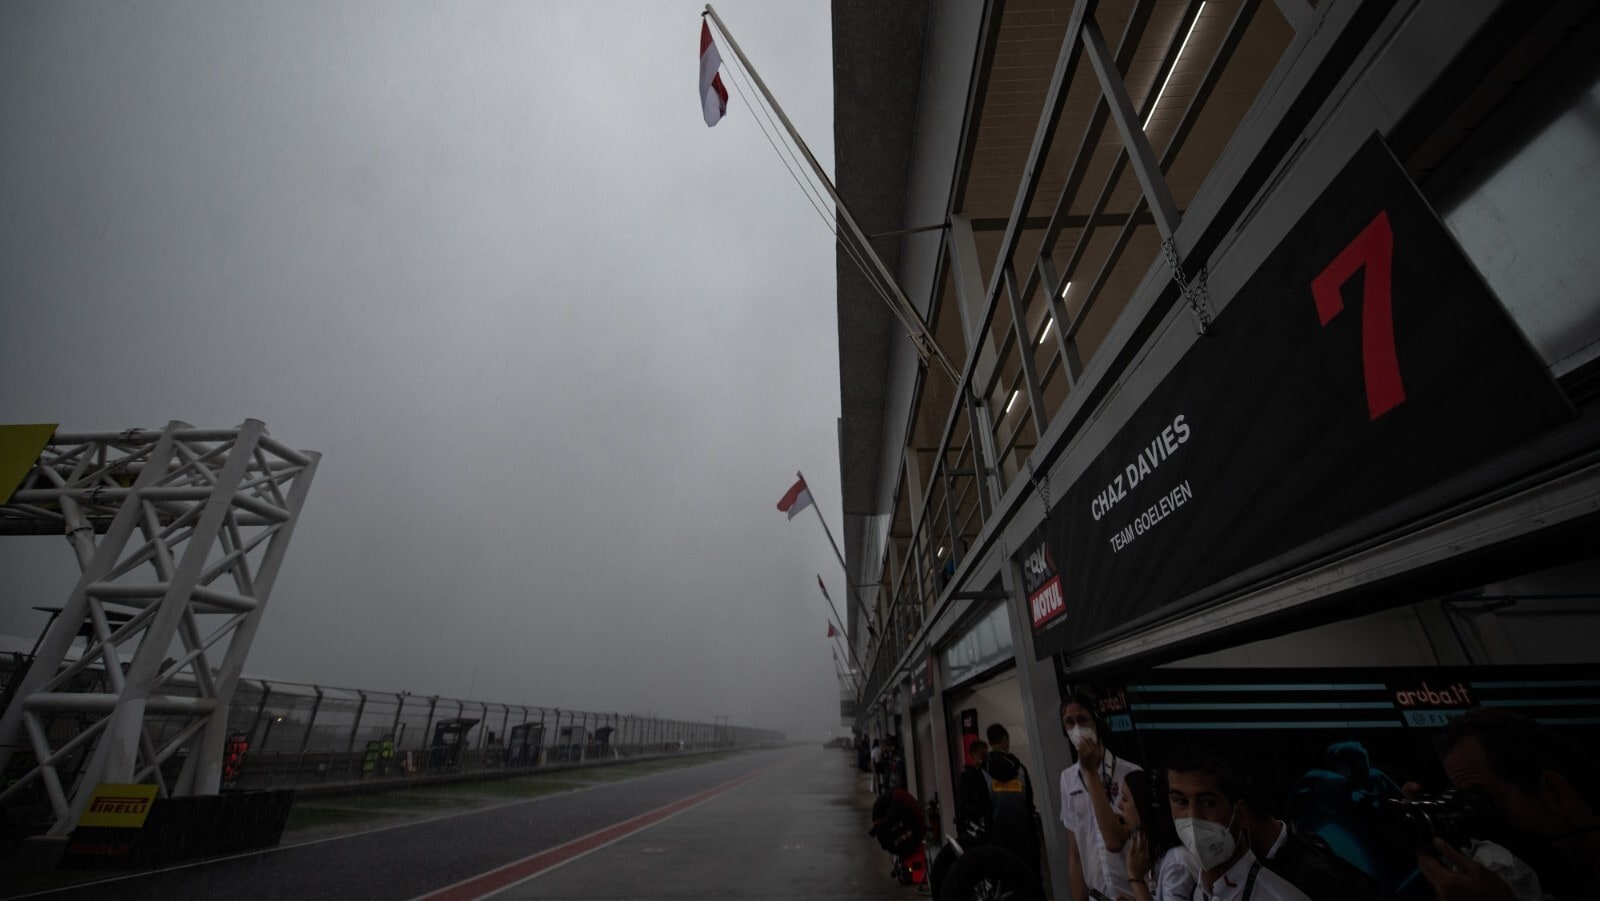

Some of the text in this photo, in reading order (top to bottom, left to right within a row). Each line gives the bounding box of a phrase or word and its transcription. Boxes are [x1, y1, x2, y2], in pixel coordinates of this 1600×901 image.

[1310, 209, 1407, 422] 7
[1091, 414, 1192, 522] CHAZ DAVIES
[1110, 480, 1193, 553] TEAM GOELEVEN
[1031, 582, 1063, 623] MOTUL
[89, 796, 150, 814] PIRELLI
